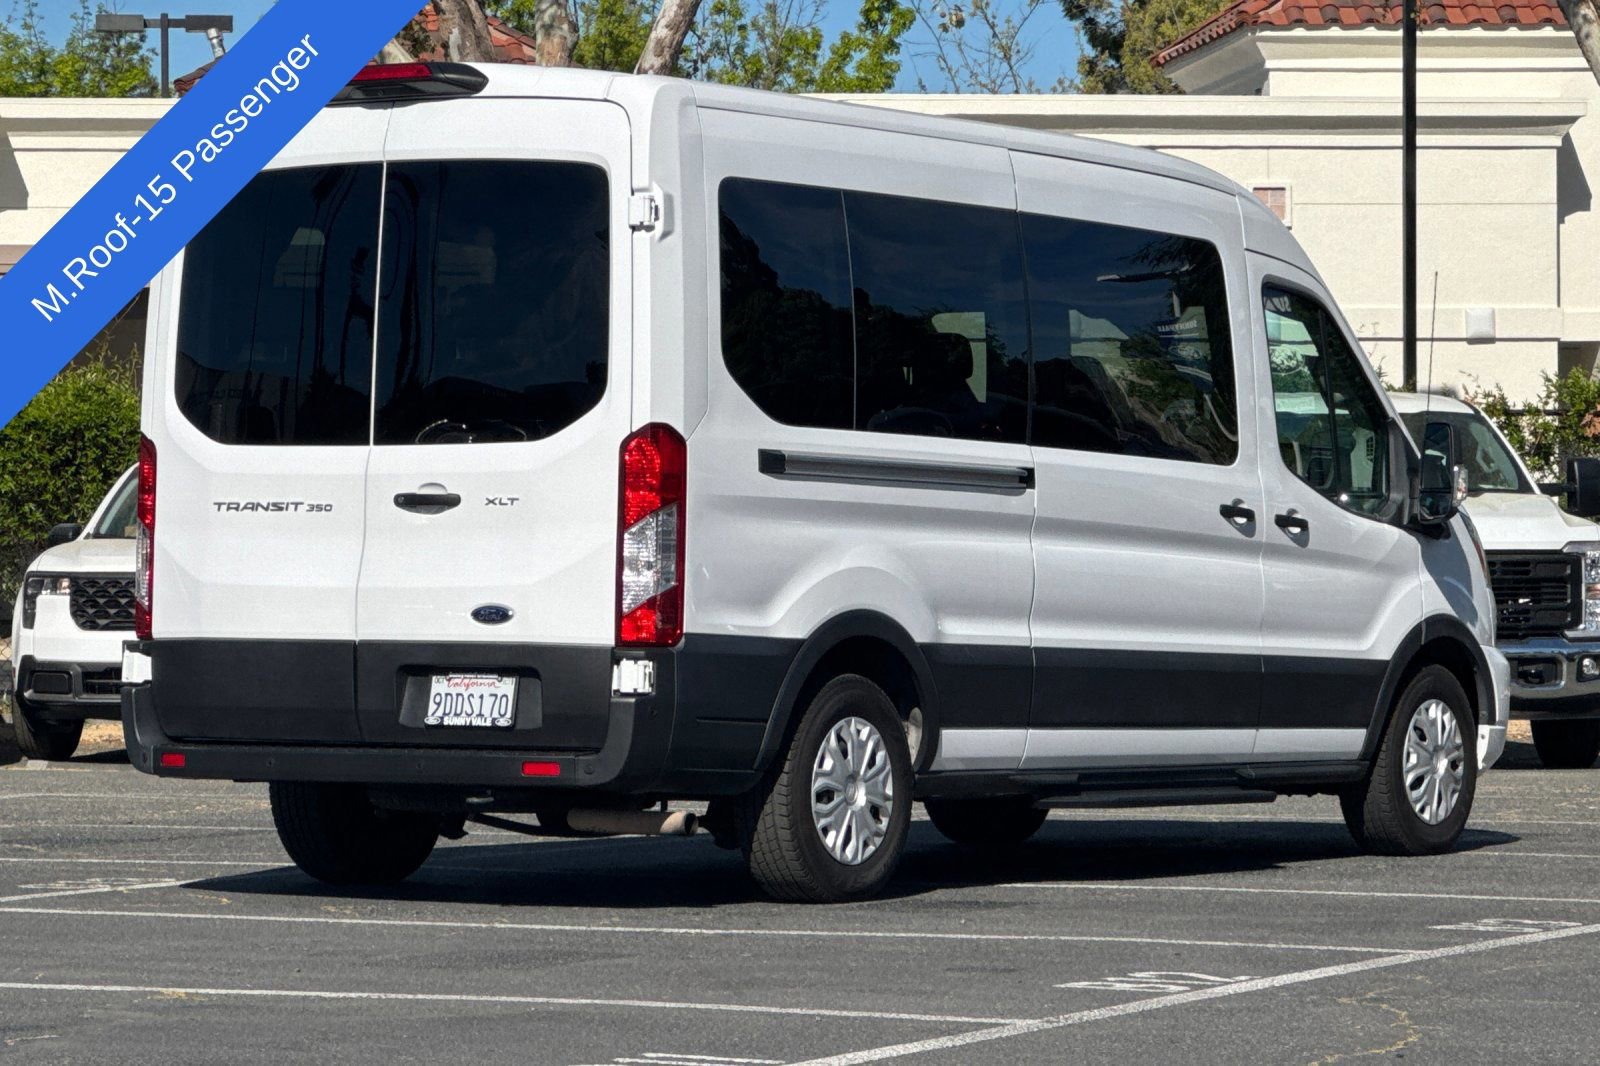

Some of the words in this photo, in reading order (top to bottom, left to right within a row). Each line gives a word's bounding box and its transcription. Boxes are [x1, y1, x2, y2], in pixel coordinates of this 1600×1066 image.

[485, 497, 519, 506] XLT
[213, 502, 304, 512] TRANSIT
[306, 504, 333, 512] 350
[431, 693, 509, 717] 9DDS170
[443, 716, 492, 726] SUNNYVALE
